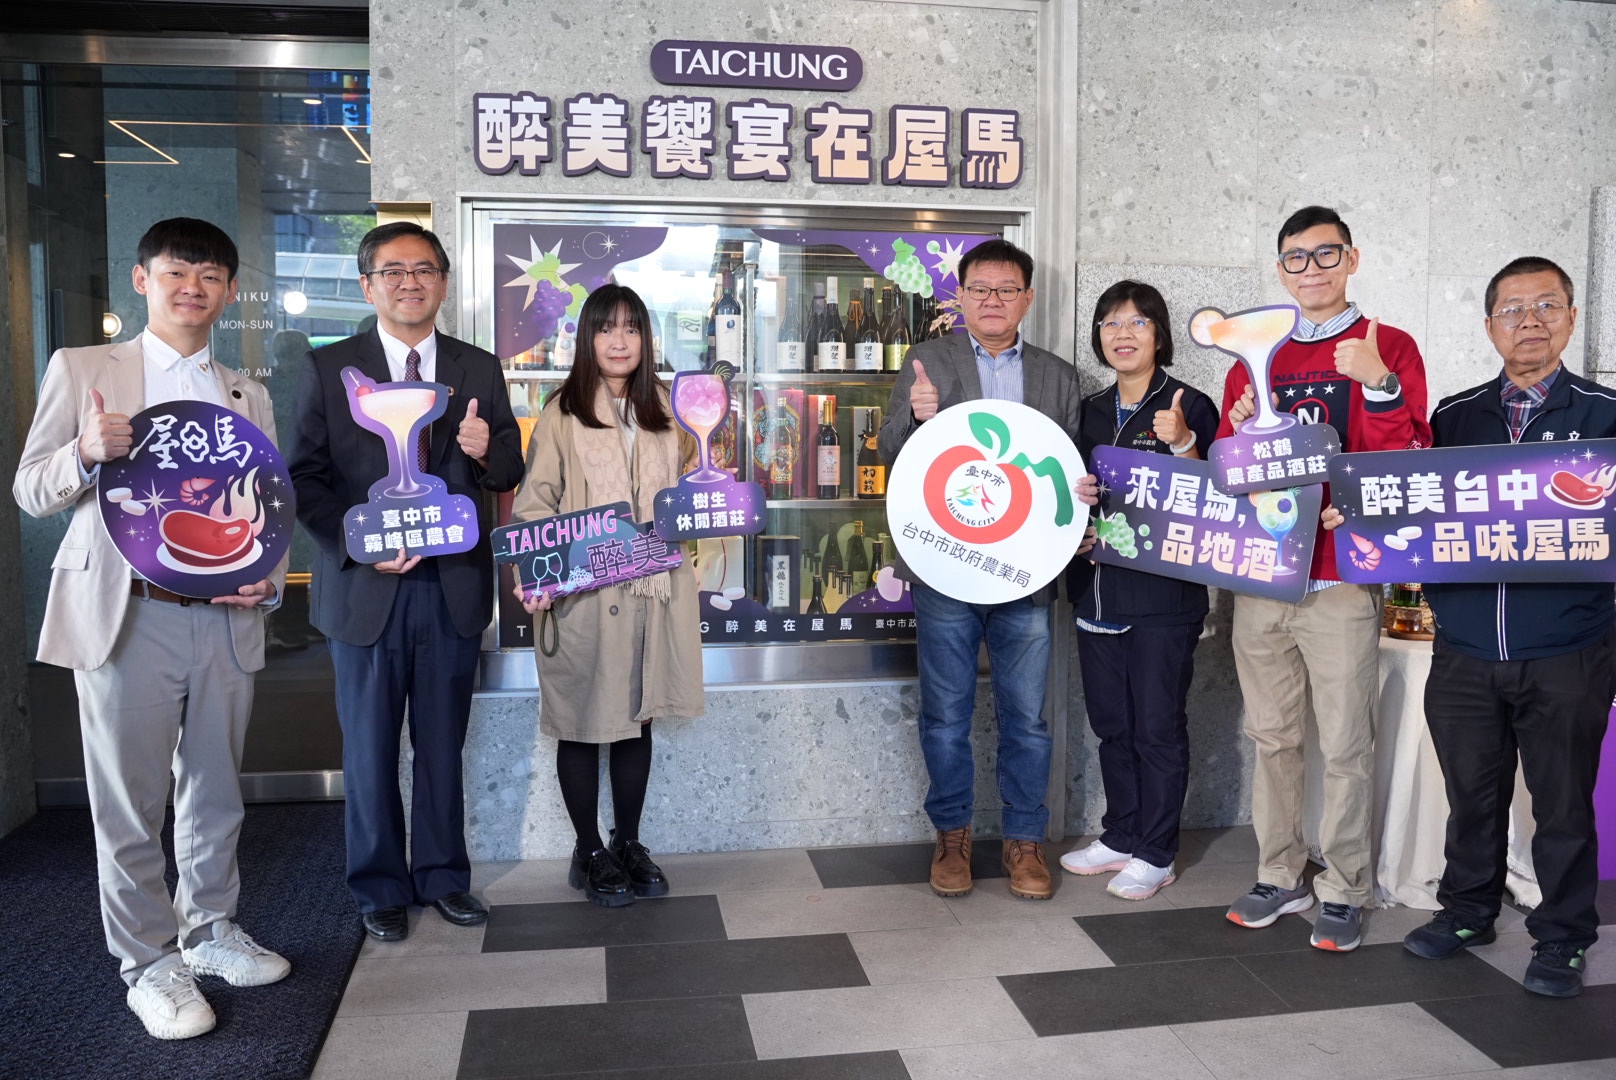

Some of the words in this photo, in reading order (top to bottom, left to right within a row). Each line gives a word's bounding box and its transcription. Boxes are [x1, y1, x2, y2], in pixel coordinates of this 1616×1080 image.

[667, 47, 848, 80] TAICHUNG
[477, 96, 1021, 185] 醉美饗宴在屋馬
[219, 320, 274, 330] MON-SUN
[255, 368, 272, 377] AM
[1274, 369, 1345, 383] NAUTIC
[1297, 406, 1320, 426] N
[1252, 438, 1293, 461] 松鶴
[964, 465, 1006, 487] 臺中市
[1226, 454, 1327, 486] 農產品酒莊
[692, 491, 727, 509] 樹生
[1360, 468, 1539, 516] 醉美台中
[381, 505, 442, 529] 臺中市
[676, 510, 745, 532] 休閒酒莊
[946, 498, 976, 526] TAICHUNG
[978, 516, 996, 527] CITY
[363, 524, 464, 553] 霧峰區農會
[506, 509, 618, 556] TAICHUNG
[1432, 517, 1610, 562] 品味屋馬
[586, 529, 668, 580] 醉美
[902, 521, 1032, 588] 台中市政府農業局
[1160, 521, 1279, 583] 品地酒
[725, 617, 853, 633] 醉美在屋馬
